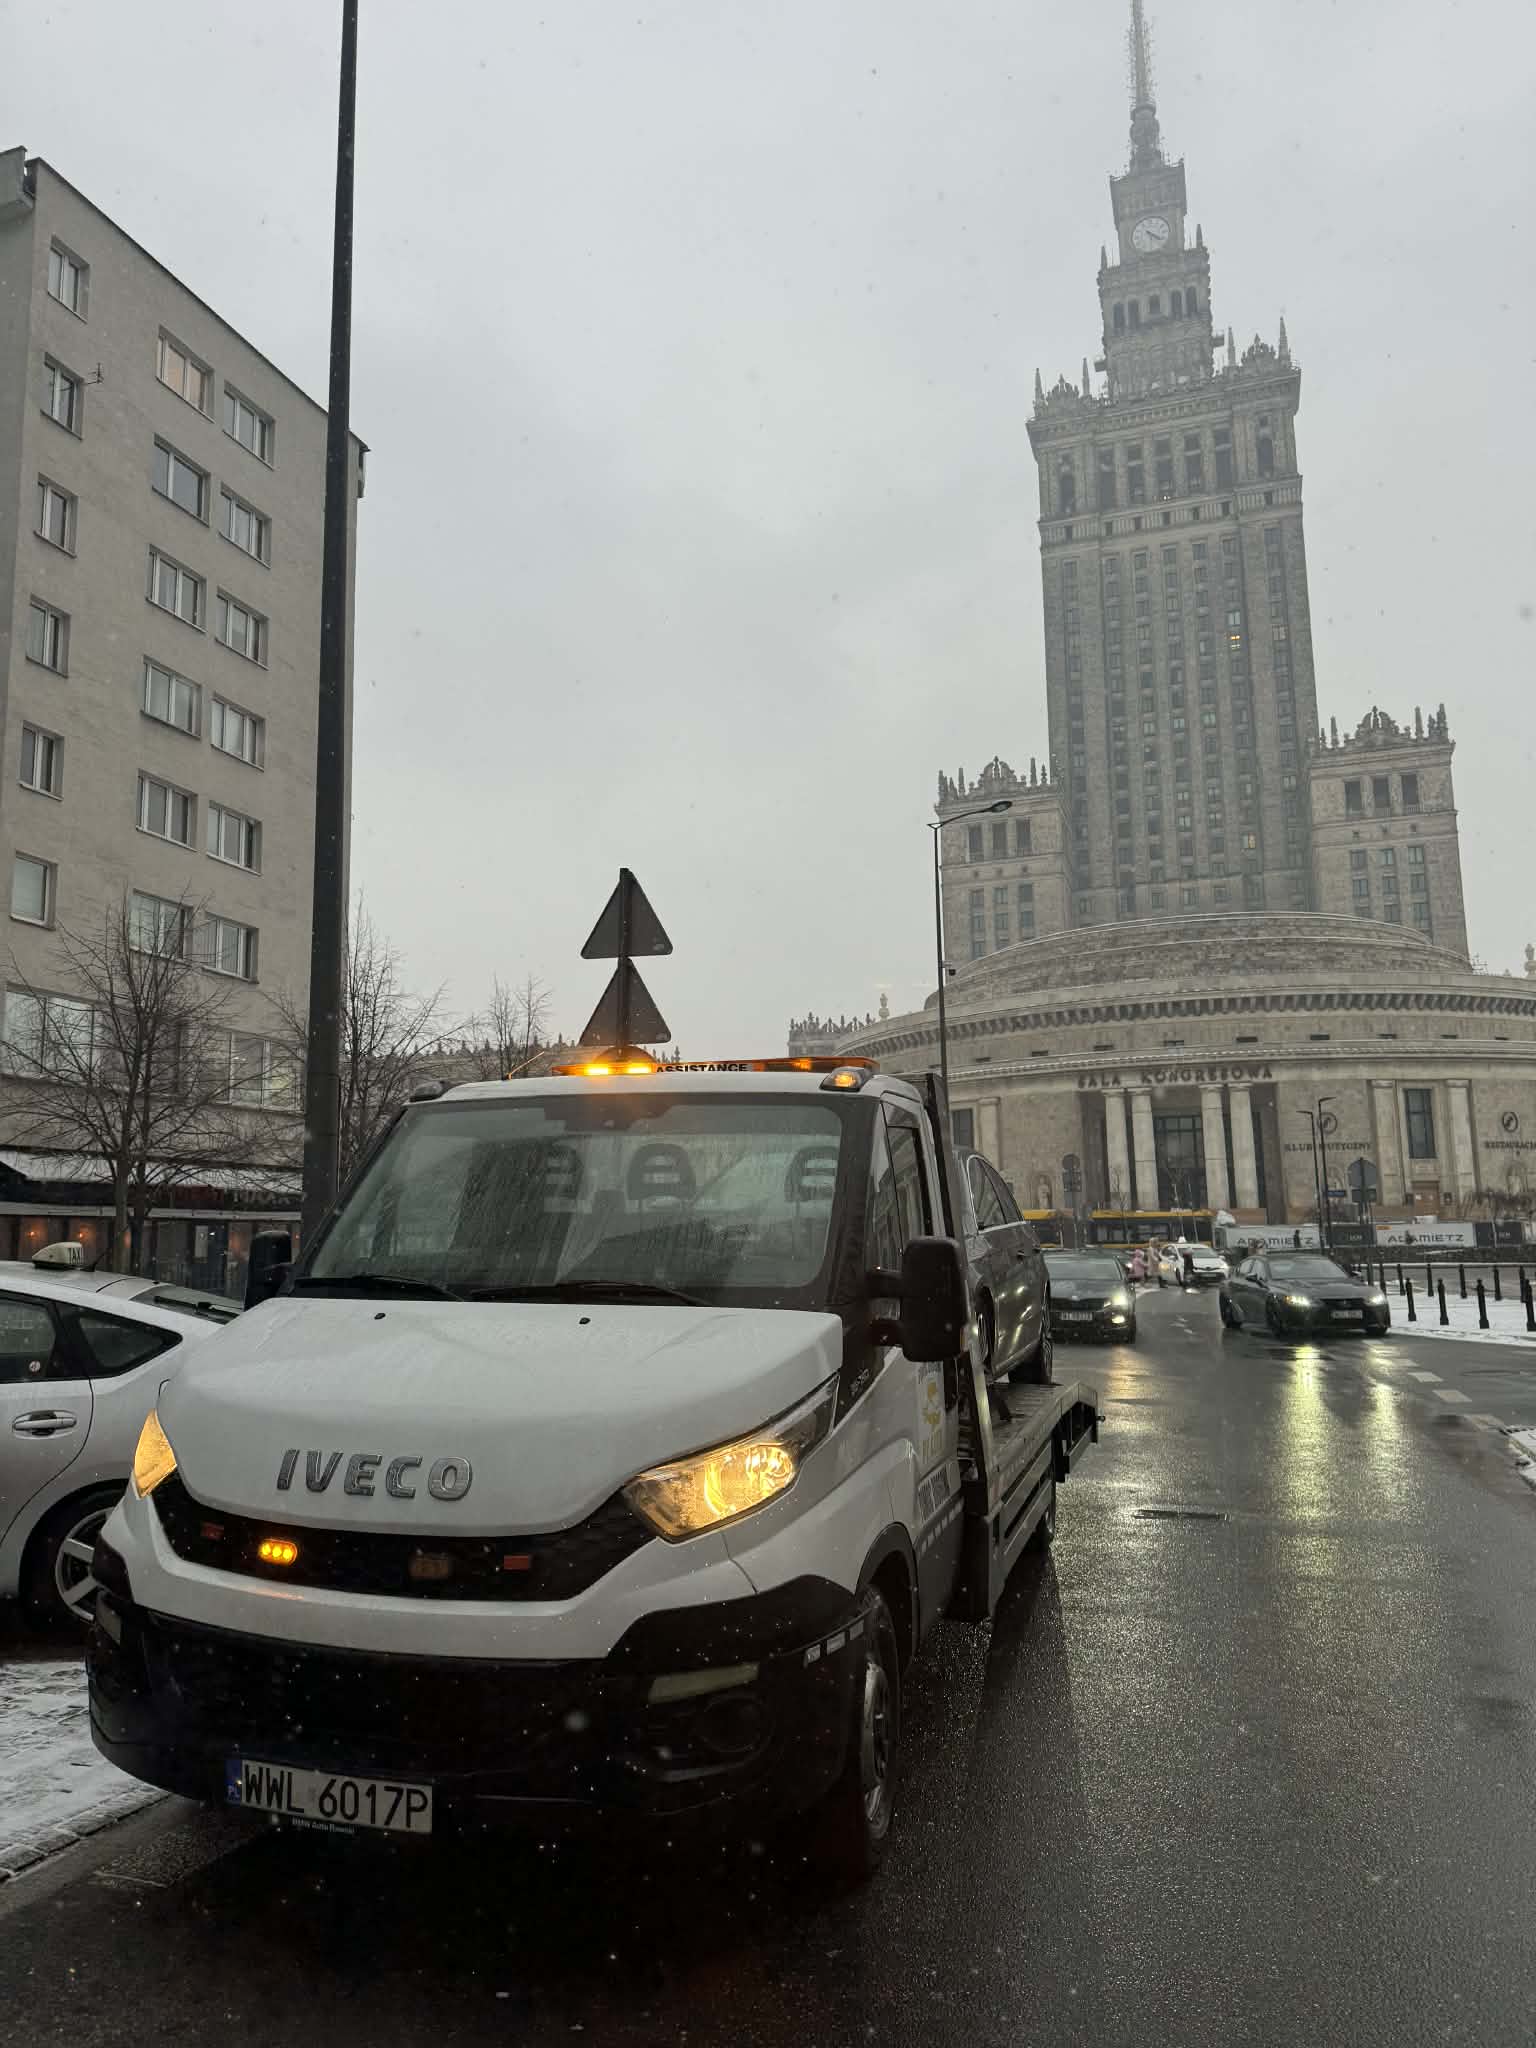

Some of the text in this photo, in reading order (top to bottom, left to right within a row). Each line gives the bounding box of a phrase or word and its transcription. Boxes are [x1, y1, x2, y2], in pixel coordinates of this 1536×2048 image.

[1077, 1066, 1273, 1088] SALA KONGRESOWA
[276, 1449, 473, 1501] IVECO
[244, 1763, 429, 1829] WWL 6017P
